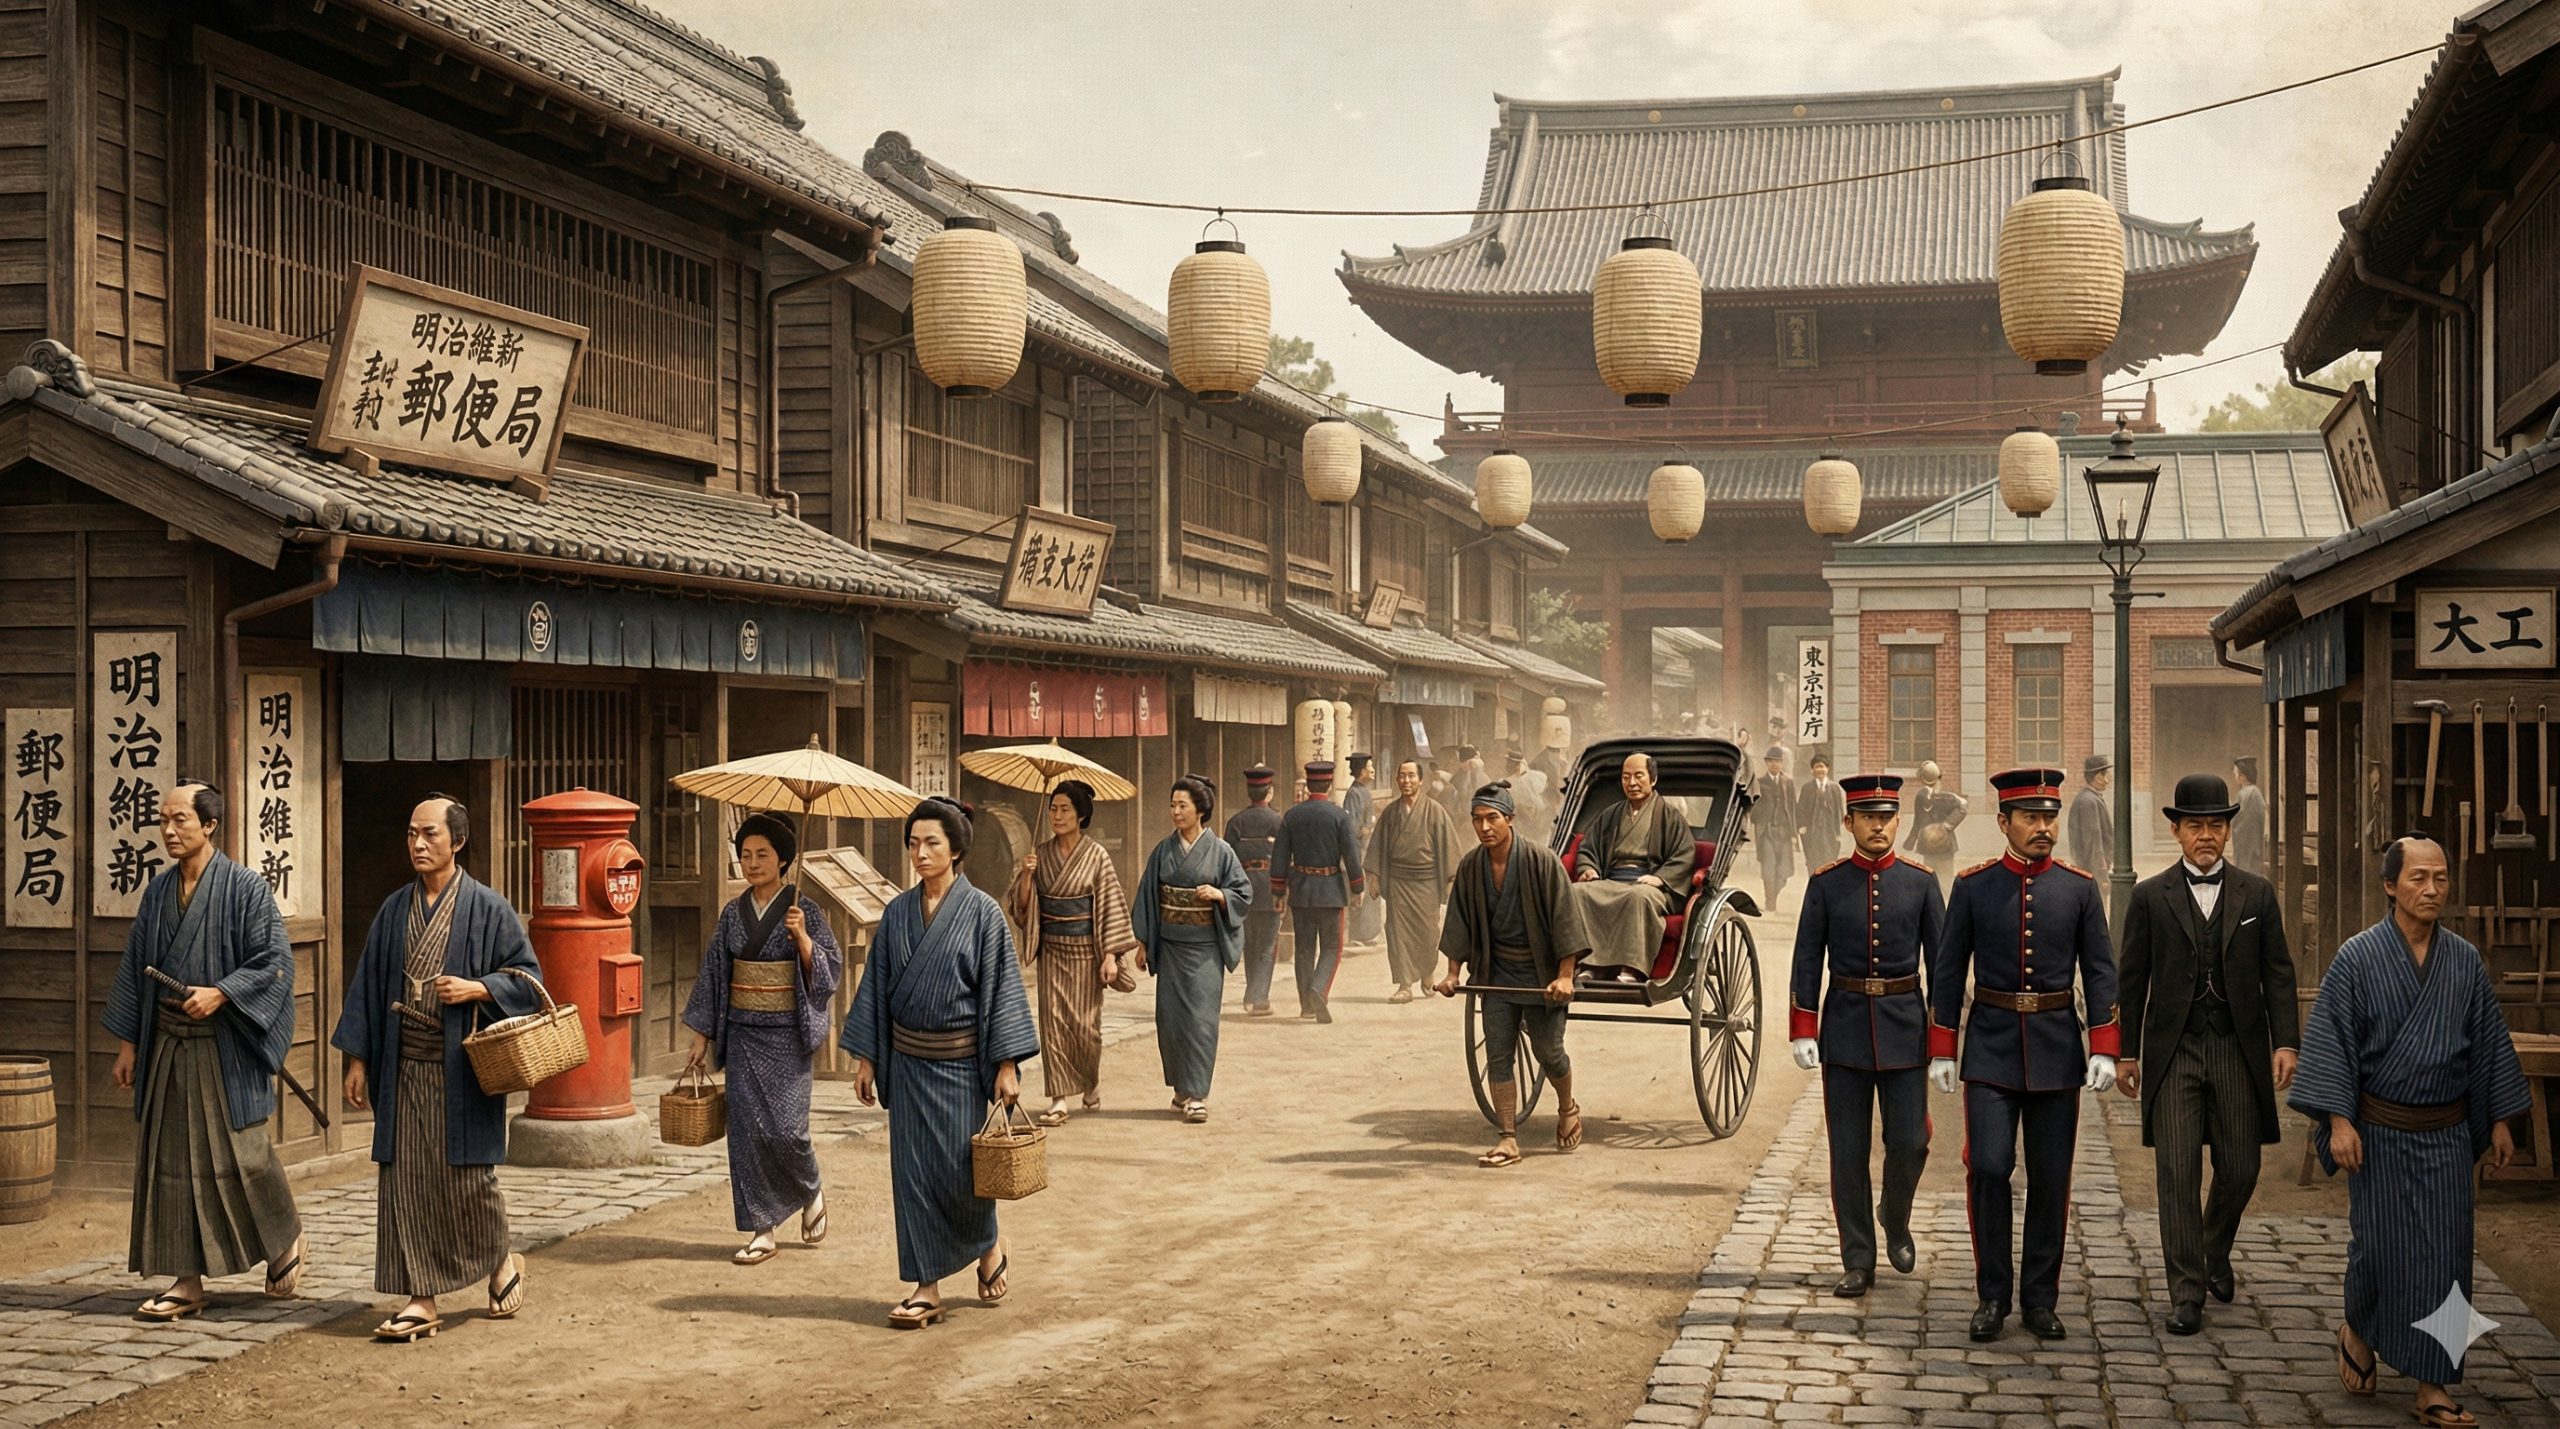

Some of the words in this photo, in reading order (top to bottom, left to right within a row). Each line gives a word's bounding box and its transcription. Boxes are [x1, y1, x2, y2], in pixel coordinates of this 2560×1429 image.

[411, 312, 525, 374] 明治維新
[398, 359, 544, 459] 郵便局
[2430, 601, 2543, 654] 大工
[1801, 645, 1825, 738] 東京府庁
[14, 728, 68, 906] 郵便局
[107, 651, 165, 897] 明治維新
[258, 691, 294, 900] 明治維新
